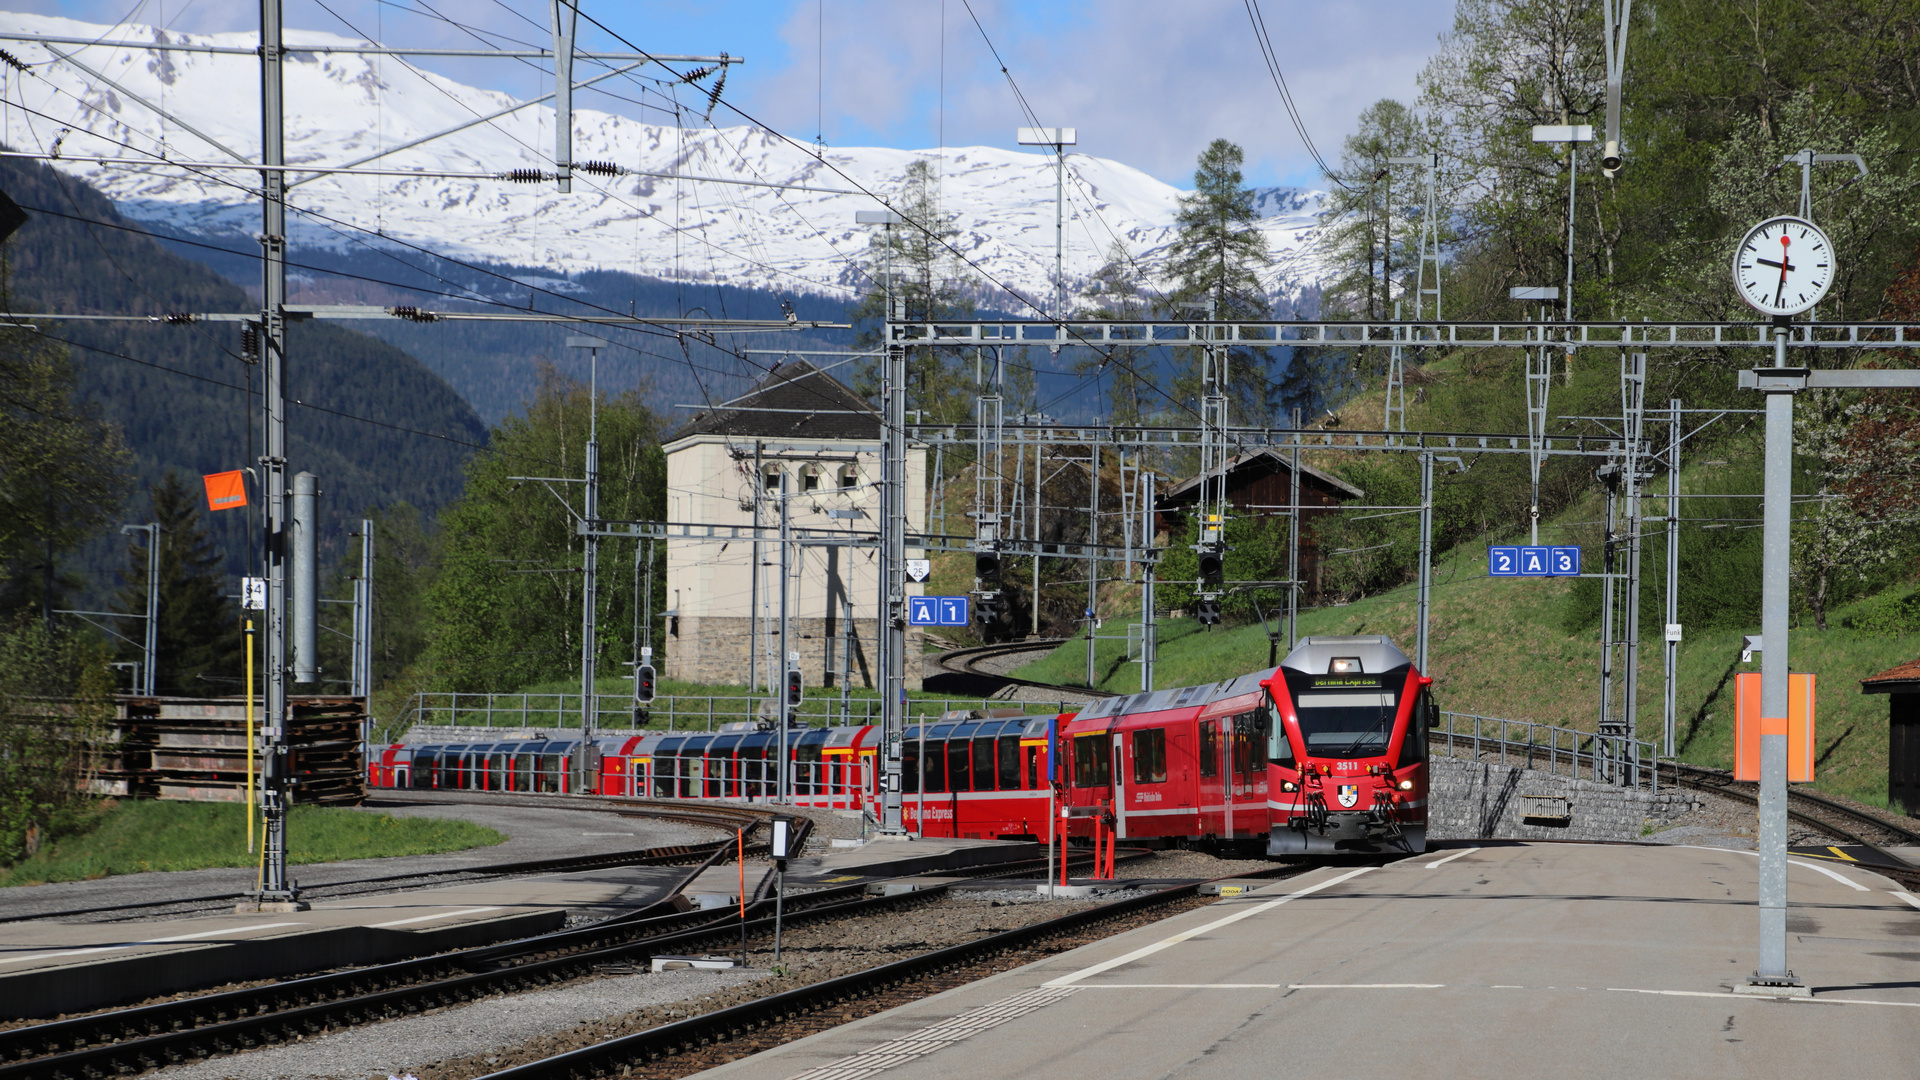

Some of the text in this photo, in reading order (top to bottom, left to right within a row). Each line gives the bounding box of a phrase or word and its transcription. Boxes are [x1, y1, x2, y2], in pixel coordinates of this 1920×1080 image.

[1498, 555, 1571, 571] 2 A 3
[913, 568, 923, 577] 25
[917, 605, 956, 621] A 1
[1315, 676, 1376, 687] Bernina Express
[1336, 761, 1358, 771] 3511
[910, 806, 953, 822] Beina Express
